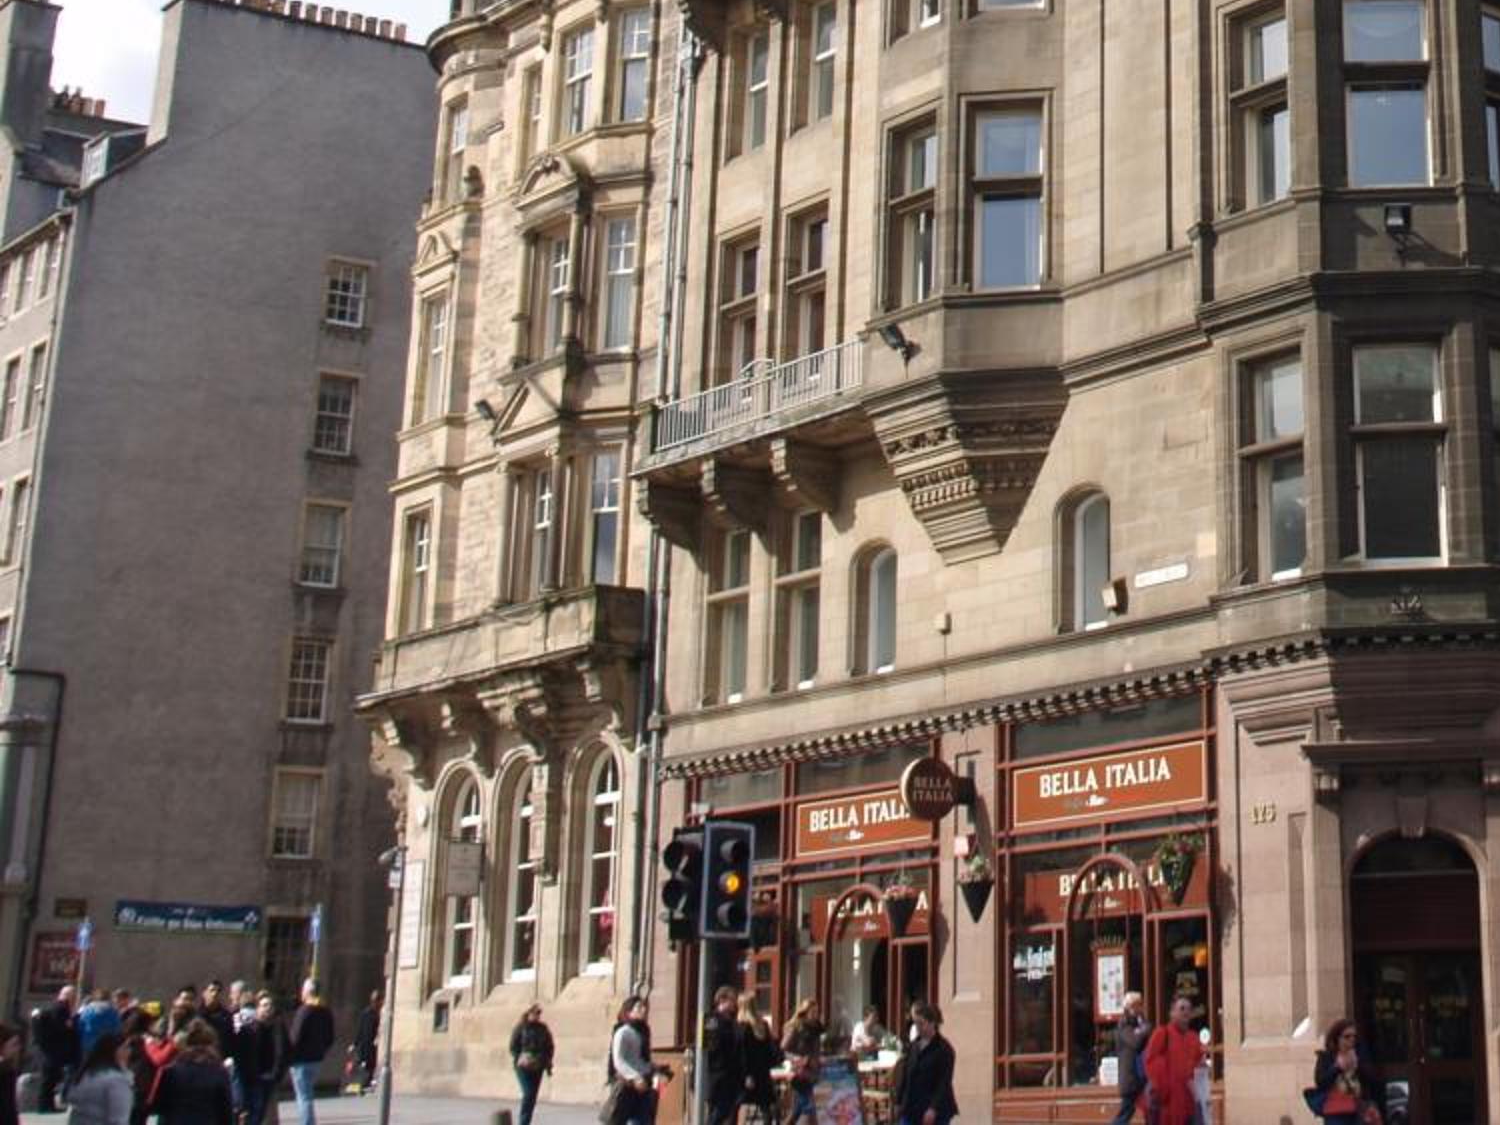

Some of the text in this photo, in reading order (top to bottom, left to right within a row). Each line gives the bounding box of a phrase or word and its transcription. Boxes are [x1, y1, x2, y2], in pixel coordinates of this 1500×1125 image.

[1040, 756, 1171, 798] BELLA ITALIA
[809, 798, 911, 832] BELLA ITALI
